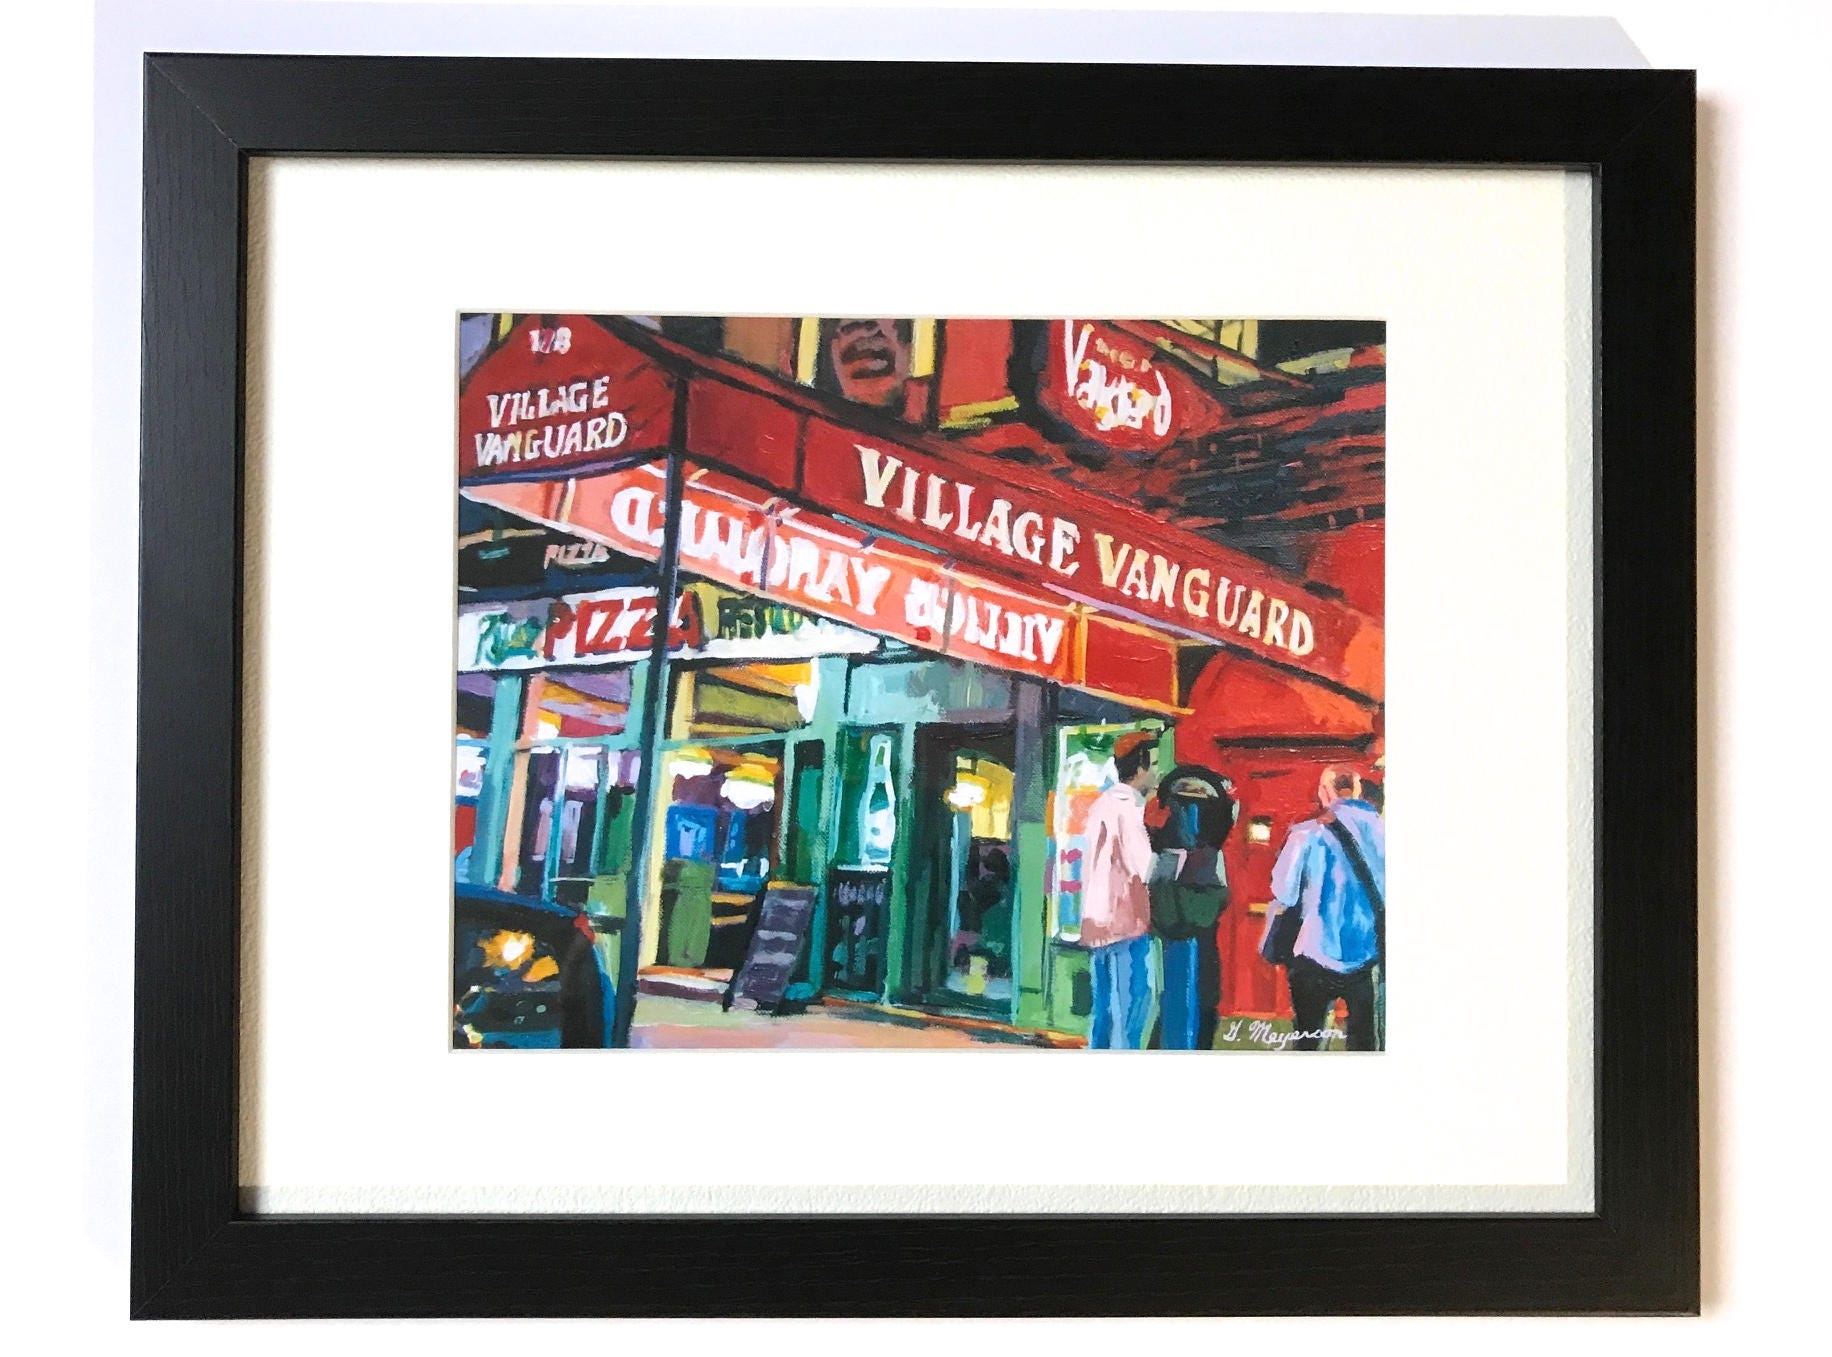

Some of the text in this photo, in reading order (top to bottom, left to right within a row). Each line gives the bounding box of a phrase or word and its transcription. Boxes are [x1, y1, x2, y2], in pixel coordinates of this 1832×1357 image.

[486, 375, 611, 428] VILLAGE
[474, 411, 628, 467] VANGUARD
[853, 444, 1316, 656] VILLAGE VANGUARD
[543, 590, 704, 662] PIZZA
